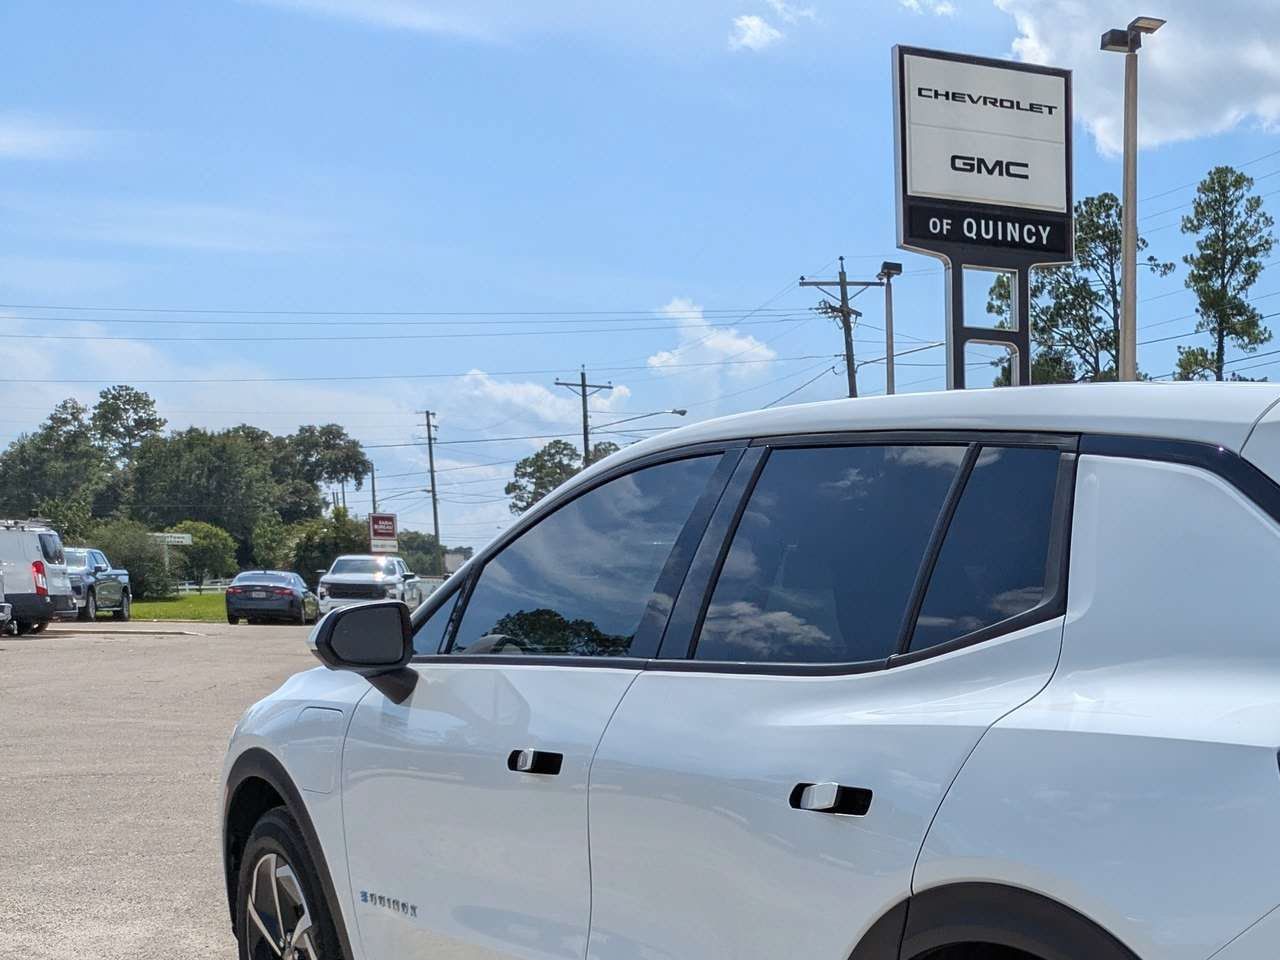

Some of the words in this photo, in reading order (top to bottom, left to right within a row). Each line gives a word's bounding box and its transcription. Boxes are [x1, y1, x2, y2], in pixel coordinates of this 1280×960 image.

[917, 87, 1058, 116] CHEVROLET
[950, 154, 1029, 180] GMC
[928, 217, 953, 236] OF
[963, 217, 1051, 246] QUINCY
